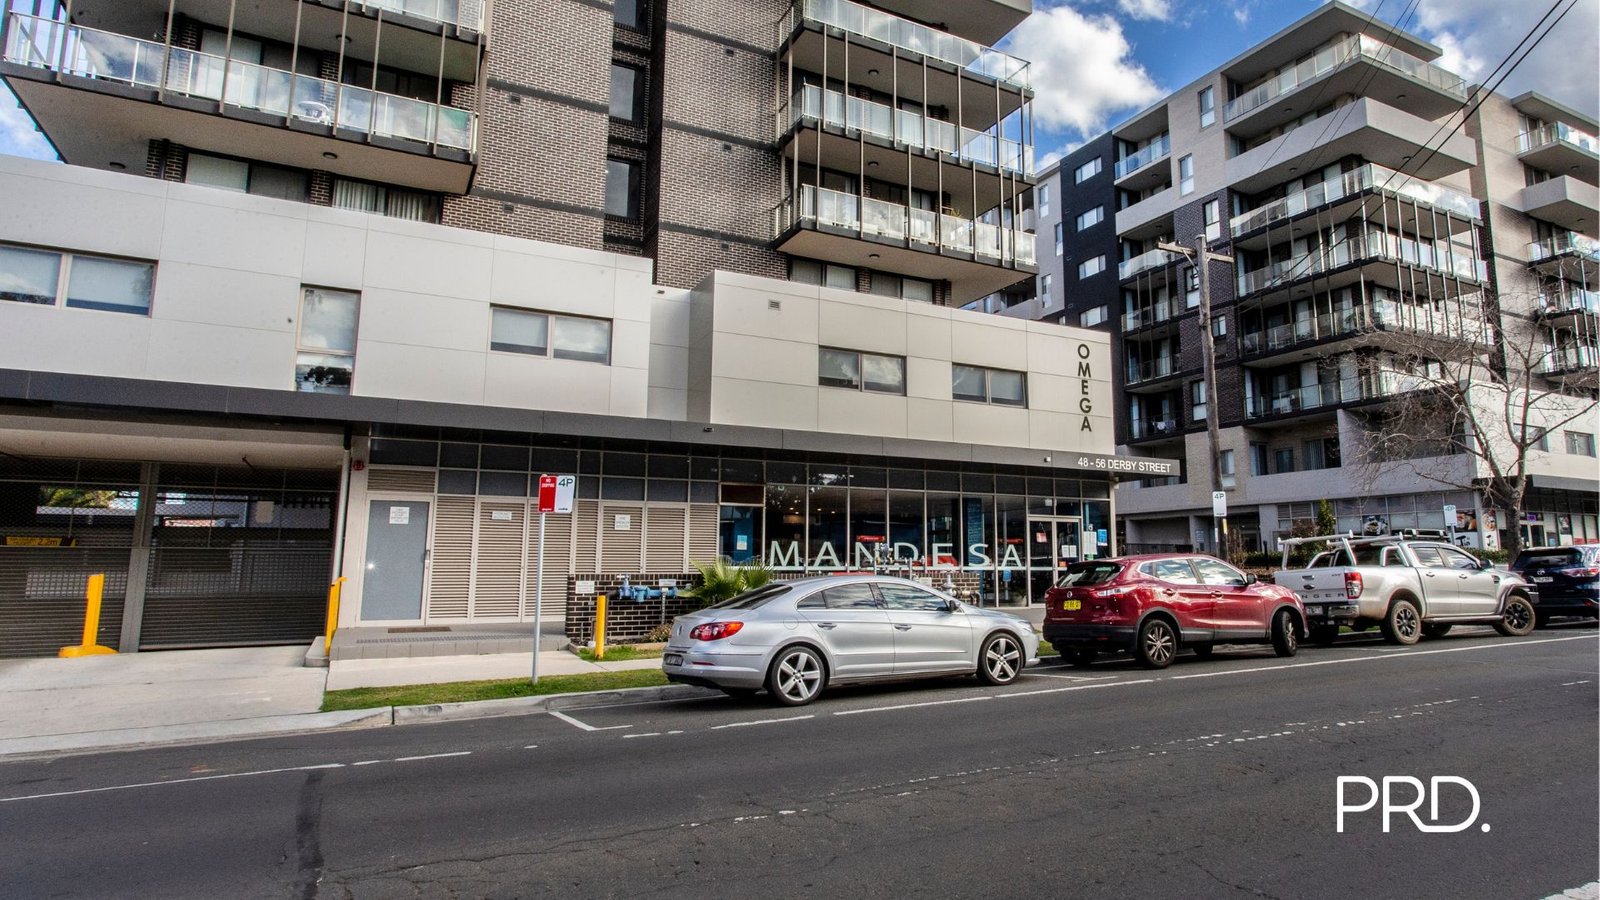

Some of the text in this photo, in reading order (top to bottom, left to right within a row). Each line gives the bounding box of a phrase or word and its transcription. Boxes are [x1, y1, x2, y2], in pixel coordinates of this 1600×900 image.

[1077, 343, 1092, 432] OMEGA
[1077, 457, 1089, 467] 48
[1095, 458, 1106, 468] 56
[1107, 459, 1137, 471] DERBY
[1138, 462, 1172, 473] STREET
[558, 478, 574, 487] 4P
[770, 540, 1024, 568] MANDESA
